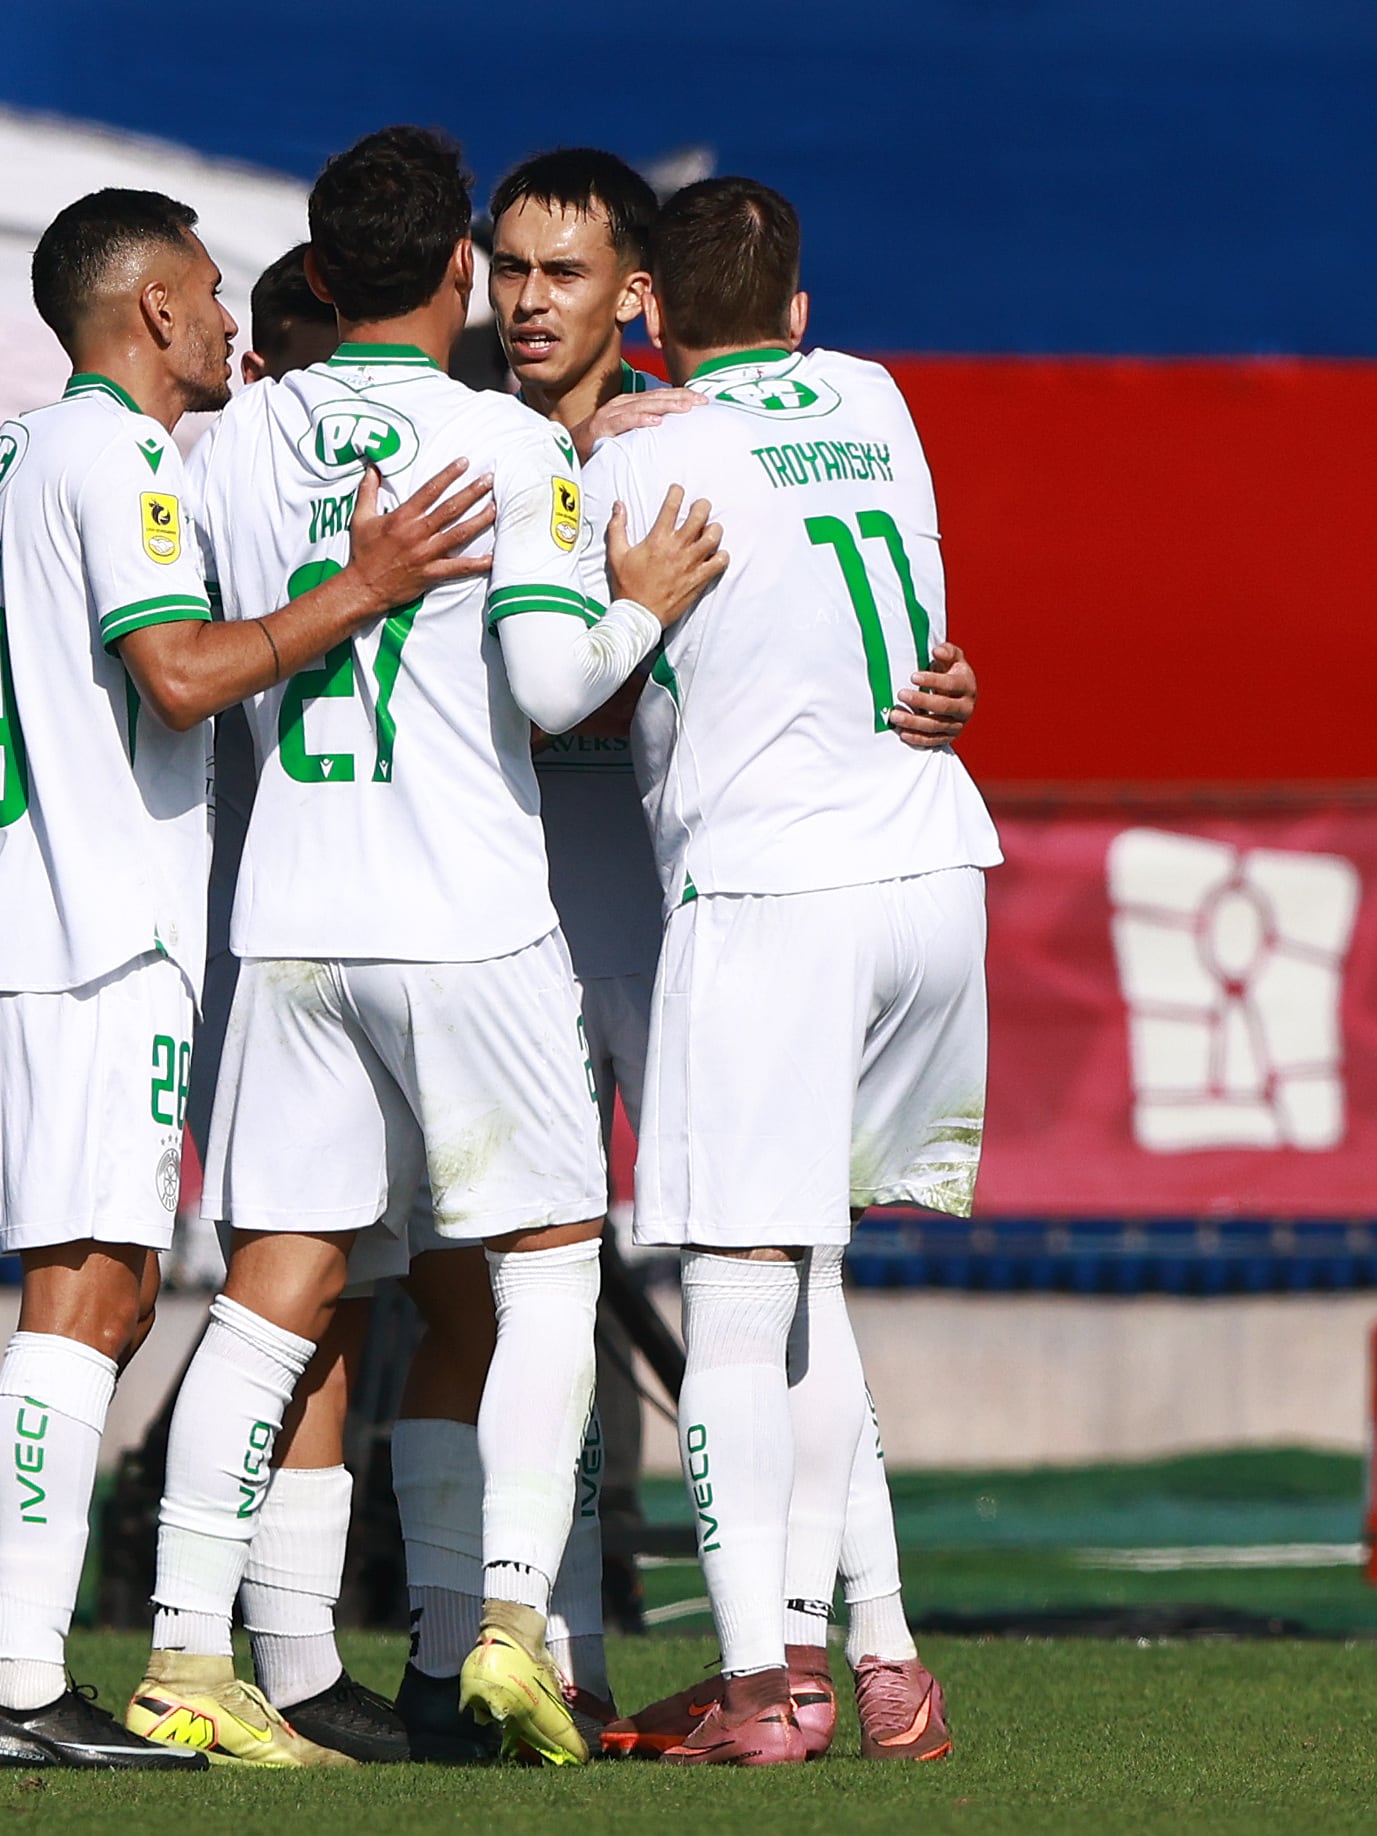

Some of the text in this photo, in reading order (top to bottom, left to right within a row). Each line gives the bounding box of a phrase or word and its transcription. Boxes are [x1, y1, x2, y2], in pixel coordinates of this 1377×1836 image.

[750, 440, 894, 489] TROYANSKY
[804, 510, 930, 734] 11
[687, 1423, 722, 1553] IVECO
